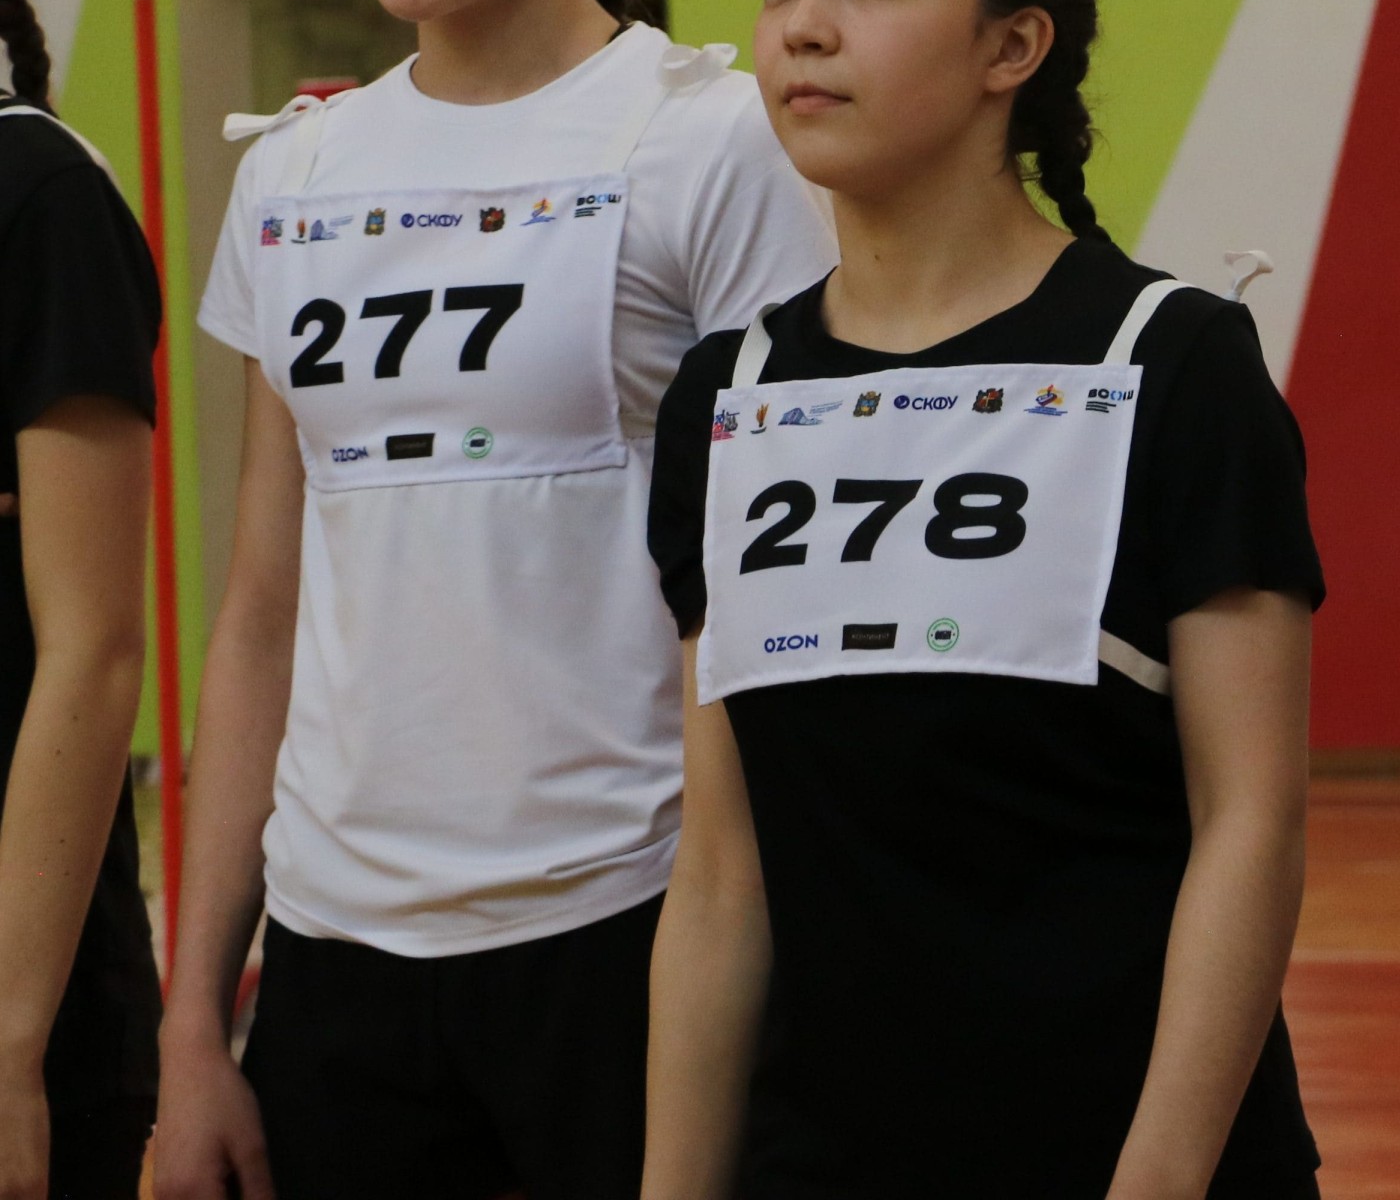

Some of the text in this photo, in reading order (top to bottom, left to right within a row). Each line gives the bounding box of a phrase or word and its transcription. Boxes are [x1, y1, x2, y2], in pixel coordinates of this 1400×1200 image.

[417, 213, 463, 227] СКФУ
[290, 283, 525, 388] 277
[911, 394, 958, 410] СКФУ
[332, 446, 369, 462] OZON
[739, 471, 1029, 575] 278
[764, 633, 818, 653] OZON
